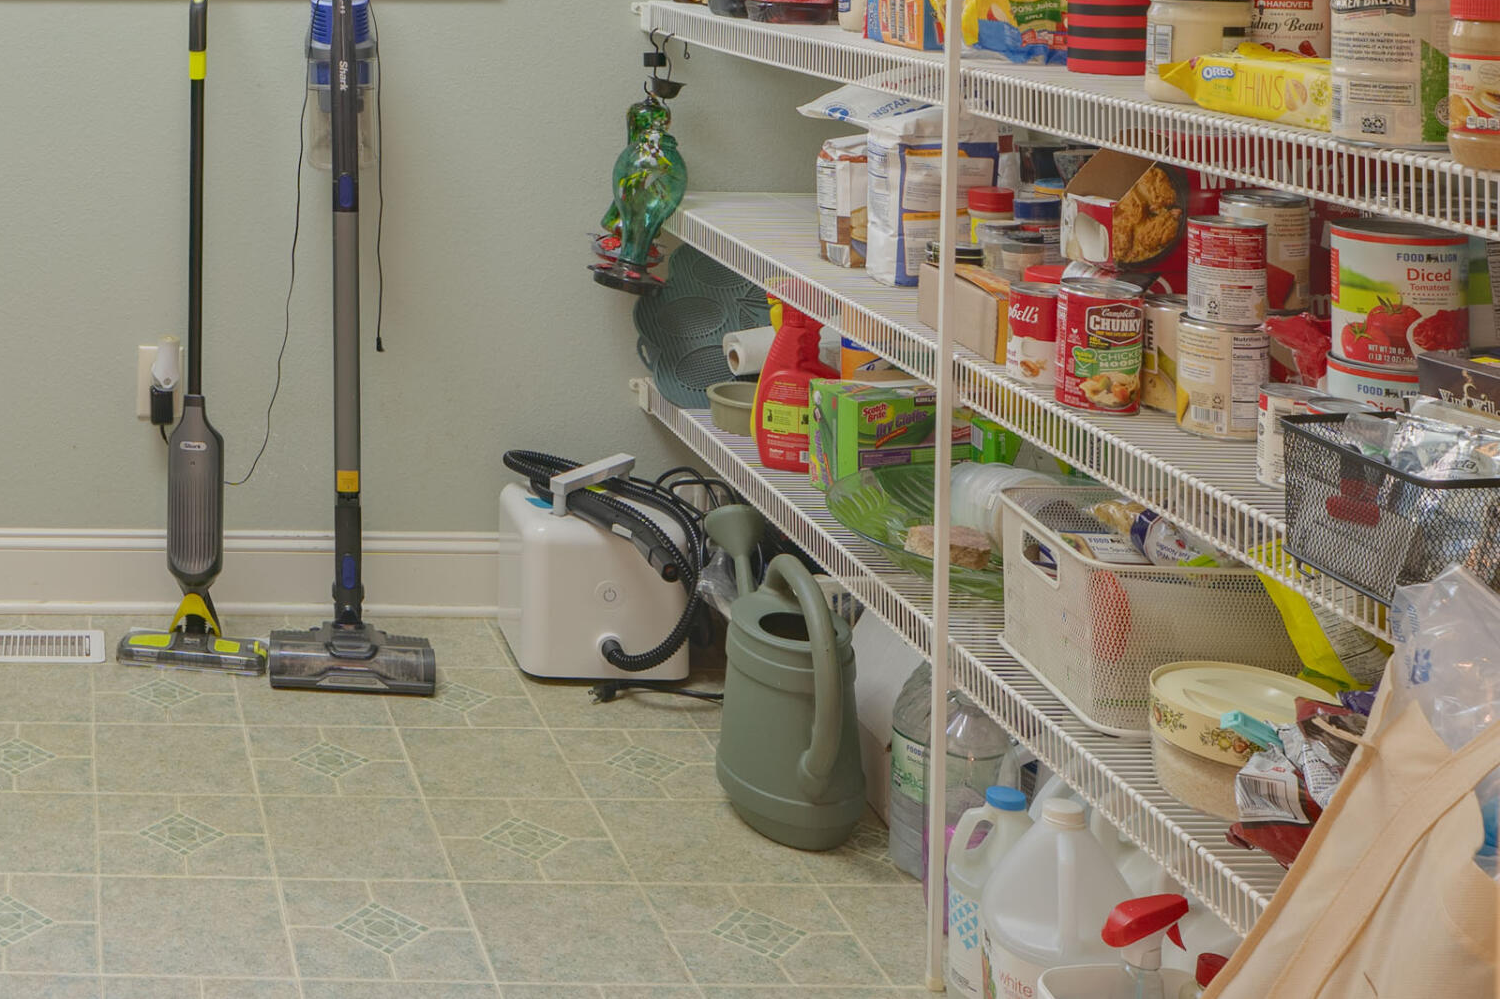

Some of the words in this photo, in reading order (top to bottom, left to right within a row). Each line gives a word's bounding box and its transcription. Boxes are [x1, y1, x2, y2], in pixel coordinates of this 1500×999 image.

[1012, 4, 1034, 14] 00%
[1266, 0, 1311, 9] HANOVER
[1251, 14, 1281, 34] idney
[1284, 17, 1323, 32] Beans
[340, 60, 348, 92] Shark
[1203, 67, 1235, 78] OREO
[1237, 69, 1284, 111] THINS
[868, 97, 911, 118] INSTAN
[1396, 253, 1425, 263] FOOD
[1440, 253, 1458, 263] LION
[1407, 268, 1452, 282] Diced
[1410, 284, 1450, 292] Tomatoes
[1009, 303, 1039, 324] bell's
[1102, 308, 1137, 318] Campbell's
[1090, 315, 1141, 332] CHUNKY
[1099, 352, 1139, 362] CHICKE
[1357, 384, 1383, 396] FOOD
[863, 403, 888, 417] Scotch
[867, 411, 887, 423] Brite
